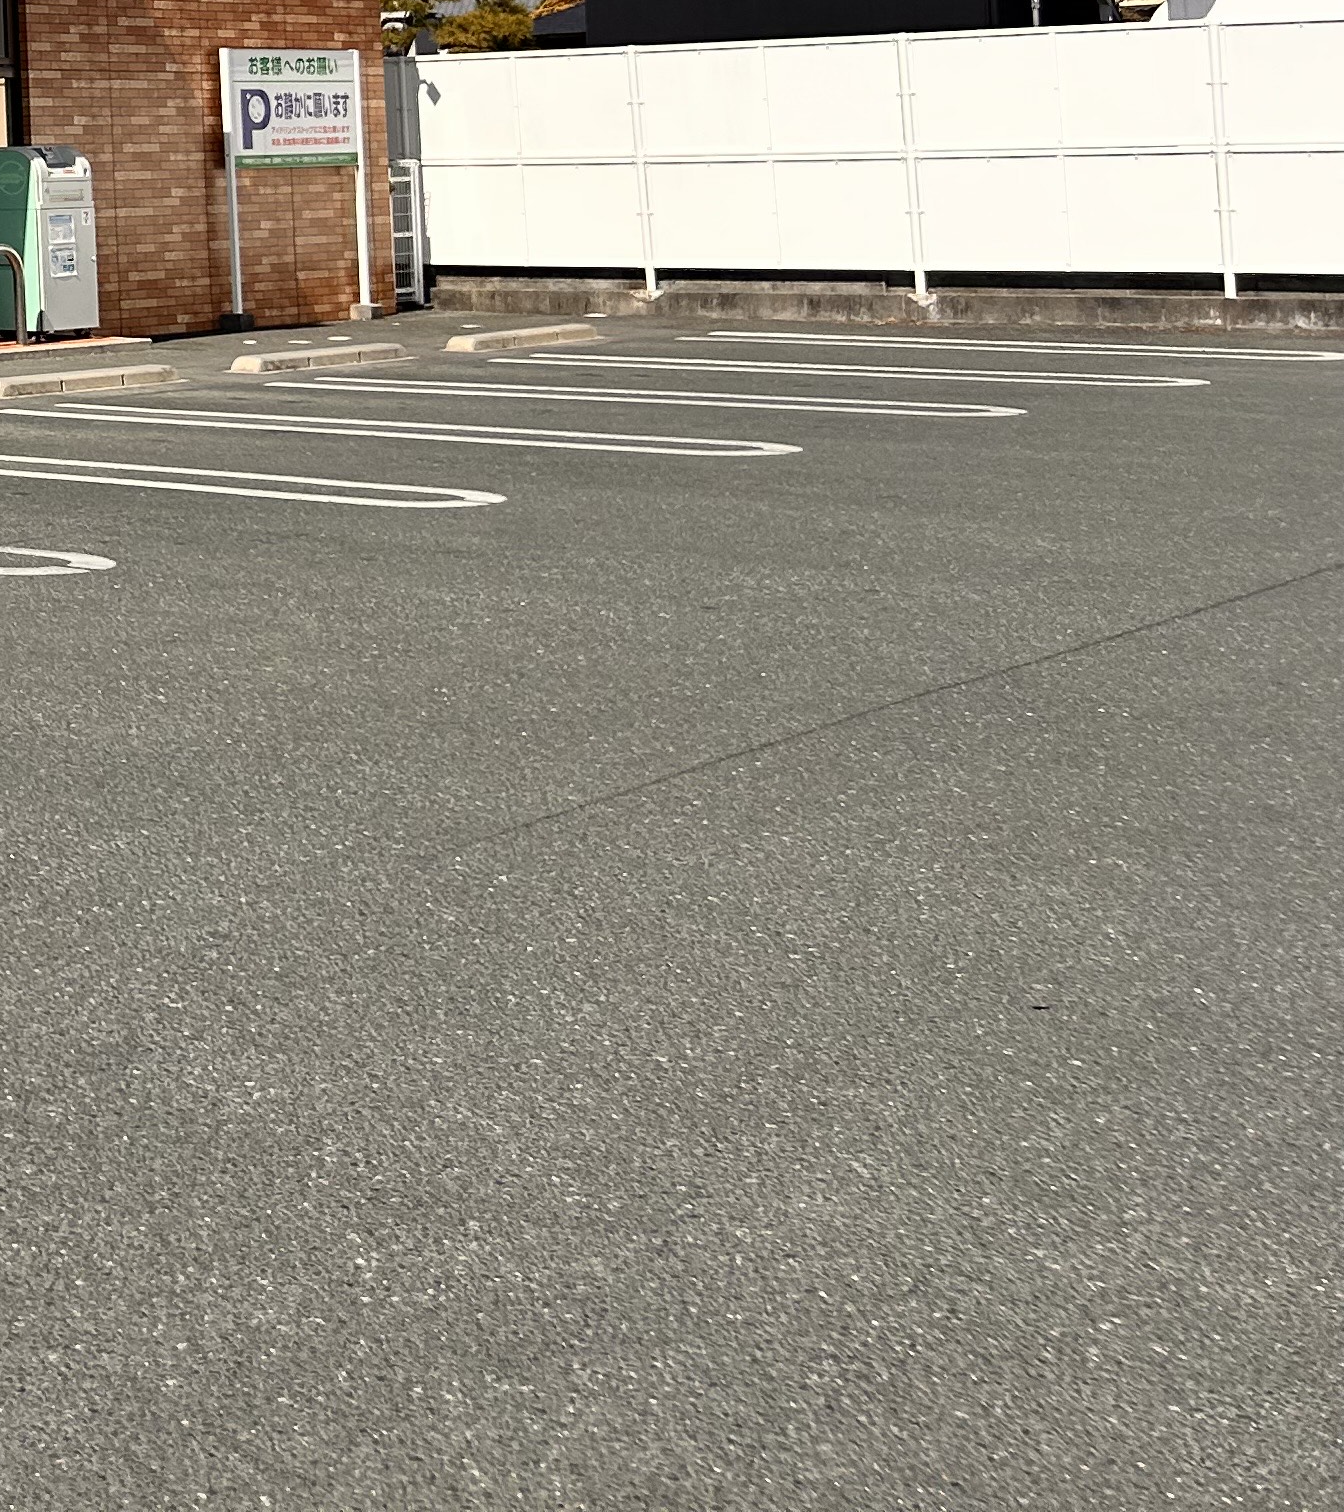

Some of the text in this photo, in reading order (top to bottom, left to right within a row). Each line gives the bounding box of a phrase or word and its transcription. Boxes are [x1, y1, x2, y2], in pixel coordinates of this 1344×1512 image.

[248, 56, 338, 76] お客様へのお願い
